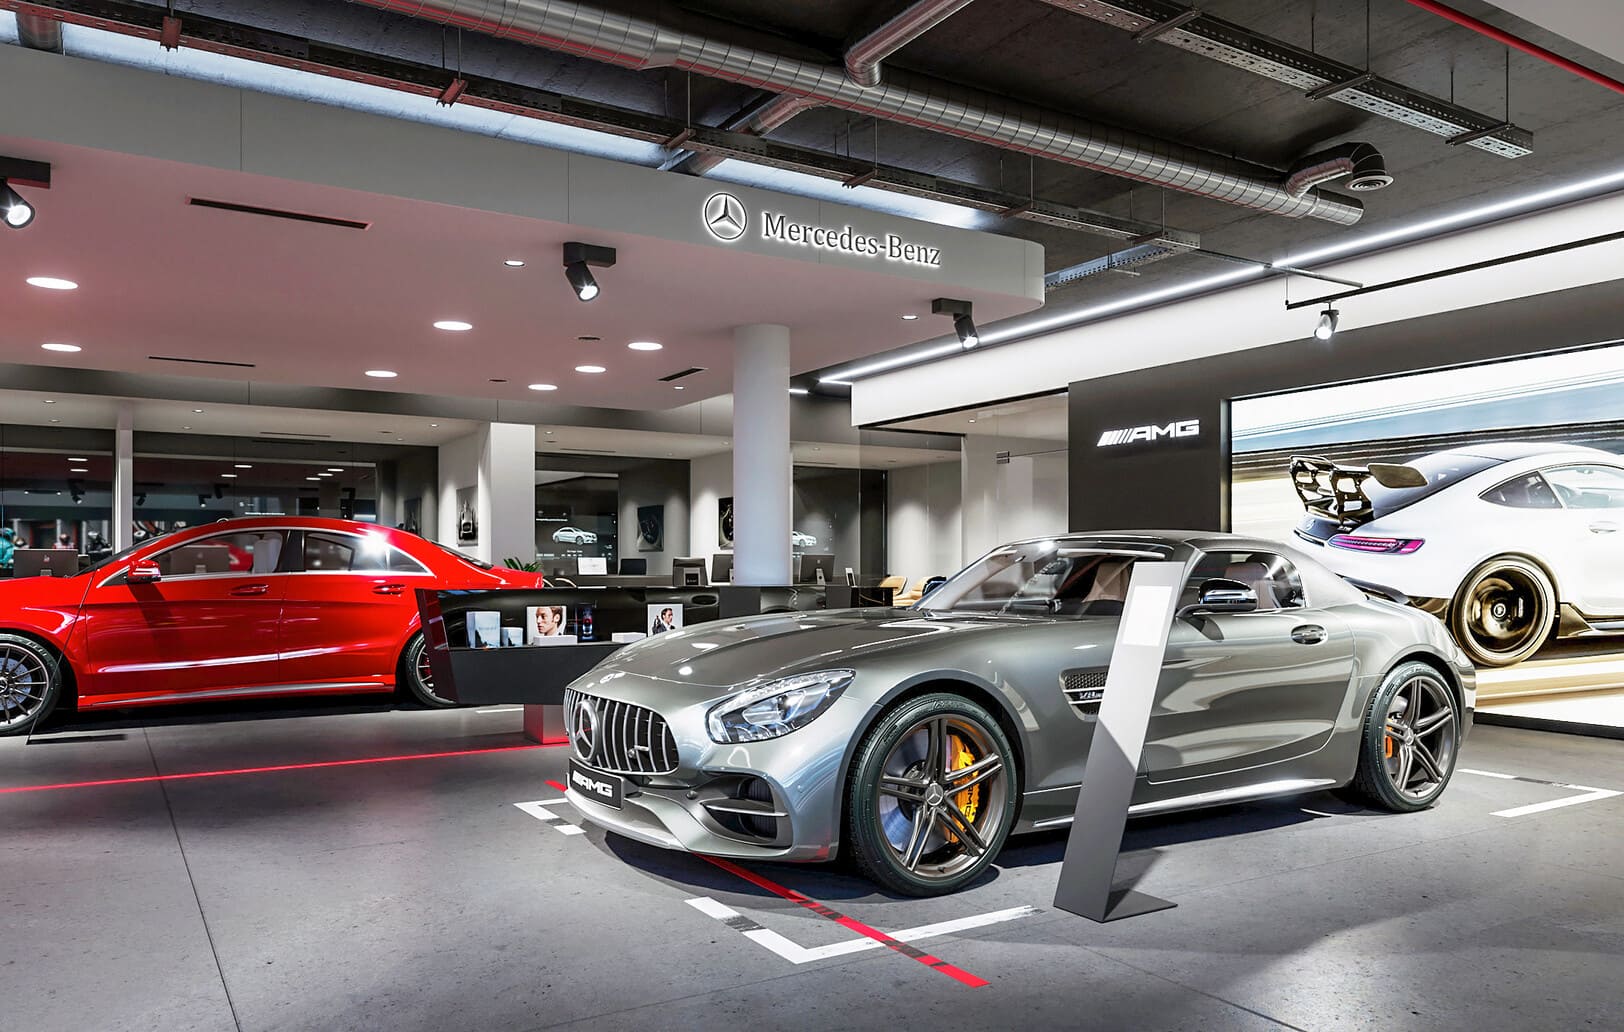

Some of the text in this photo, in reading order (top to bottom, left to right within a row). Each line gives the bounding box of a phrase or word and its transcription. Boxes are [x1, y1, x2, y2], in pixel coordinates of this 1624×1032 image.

[763, 212, 942, 266] Mercedes-Benz
[1125, 419, 1200, 443] AMG
[578, 773, 612, 797] AMG
